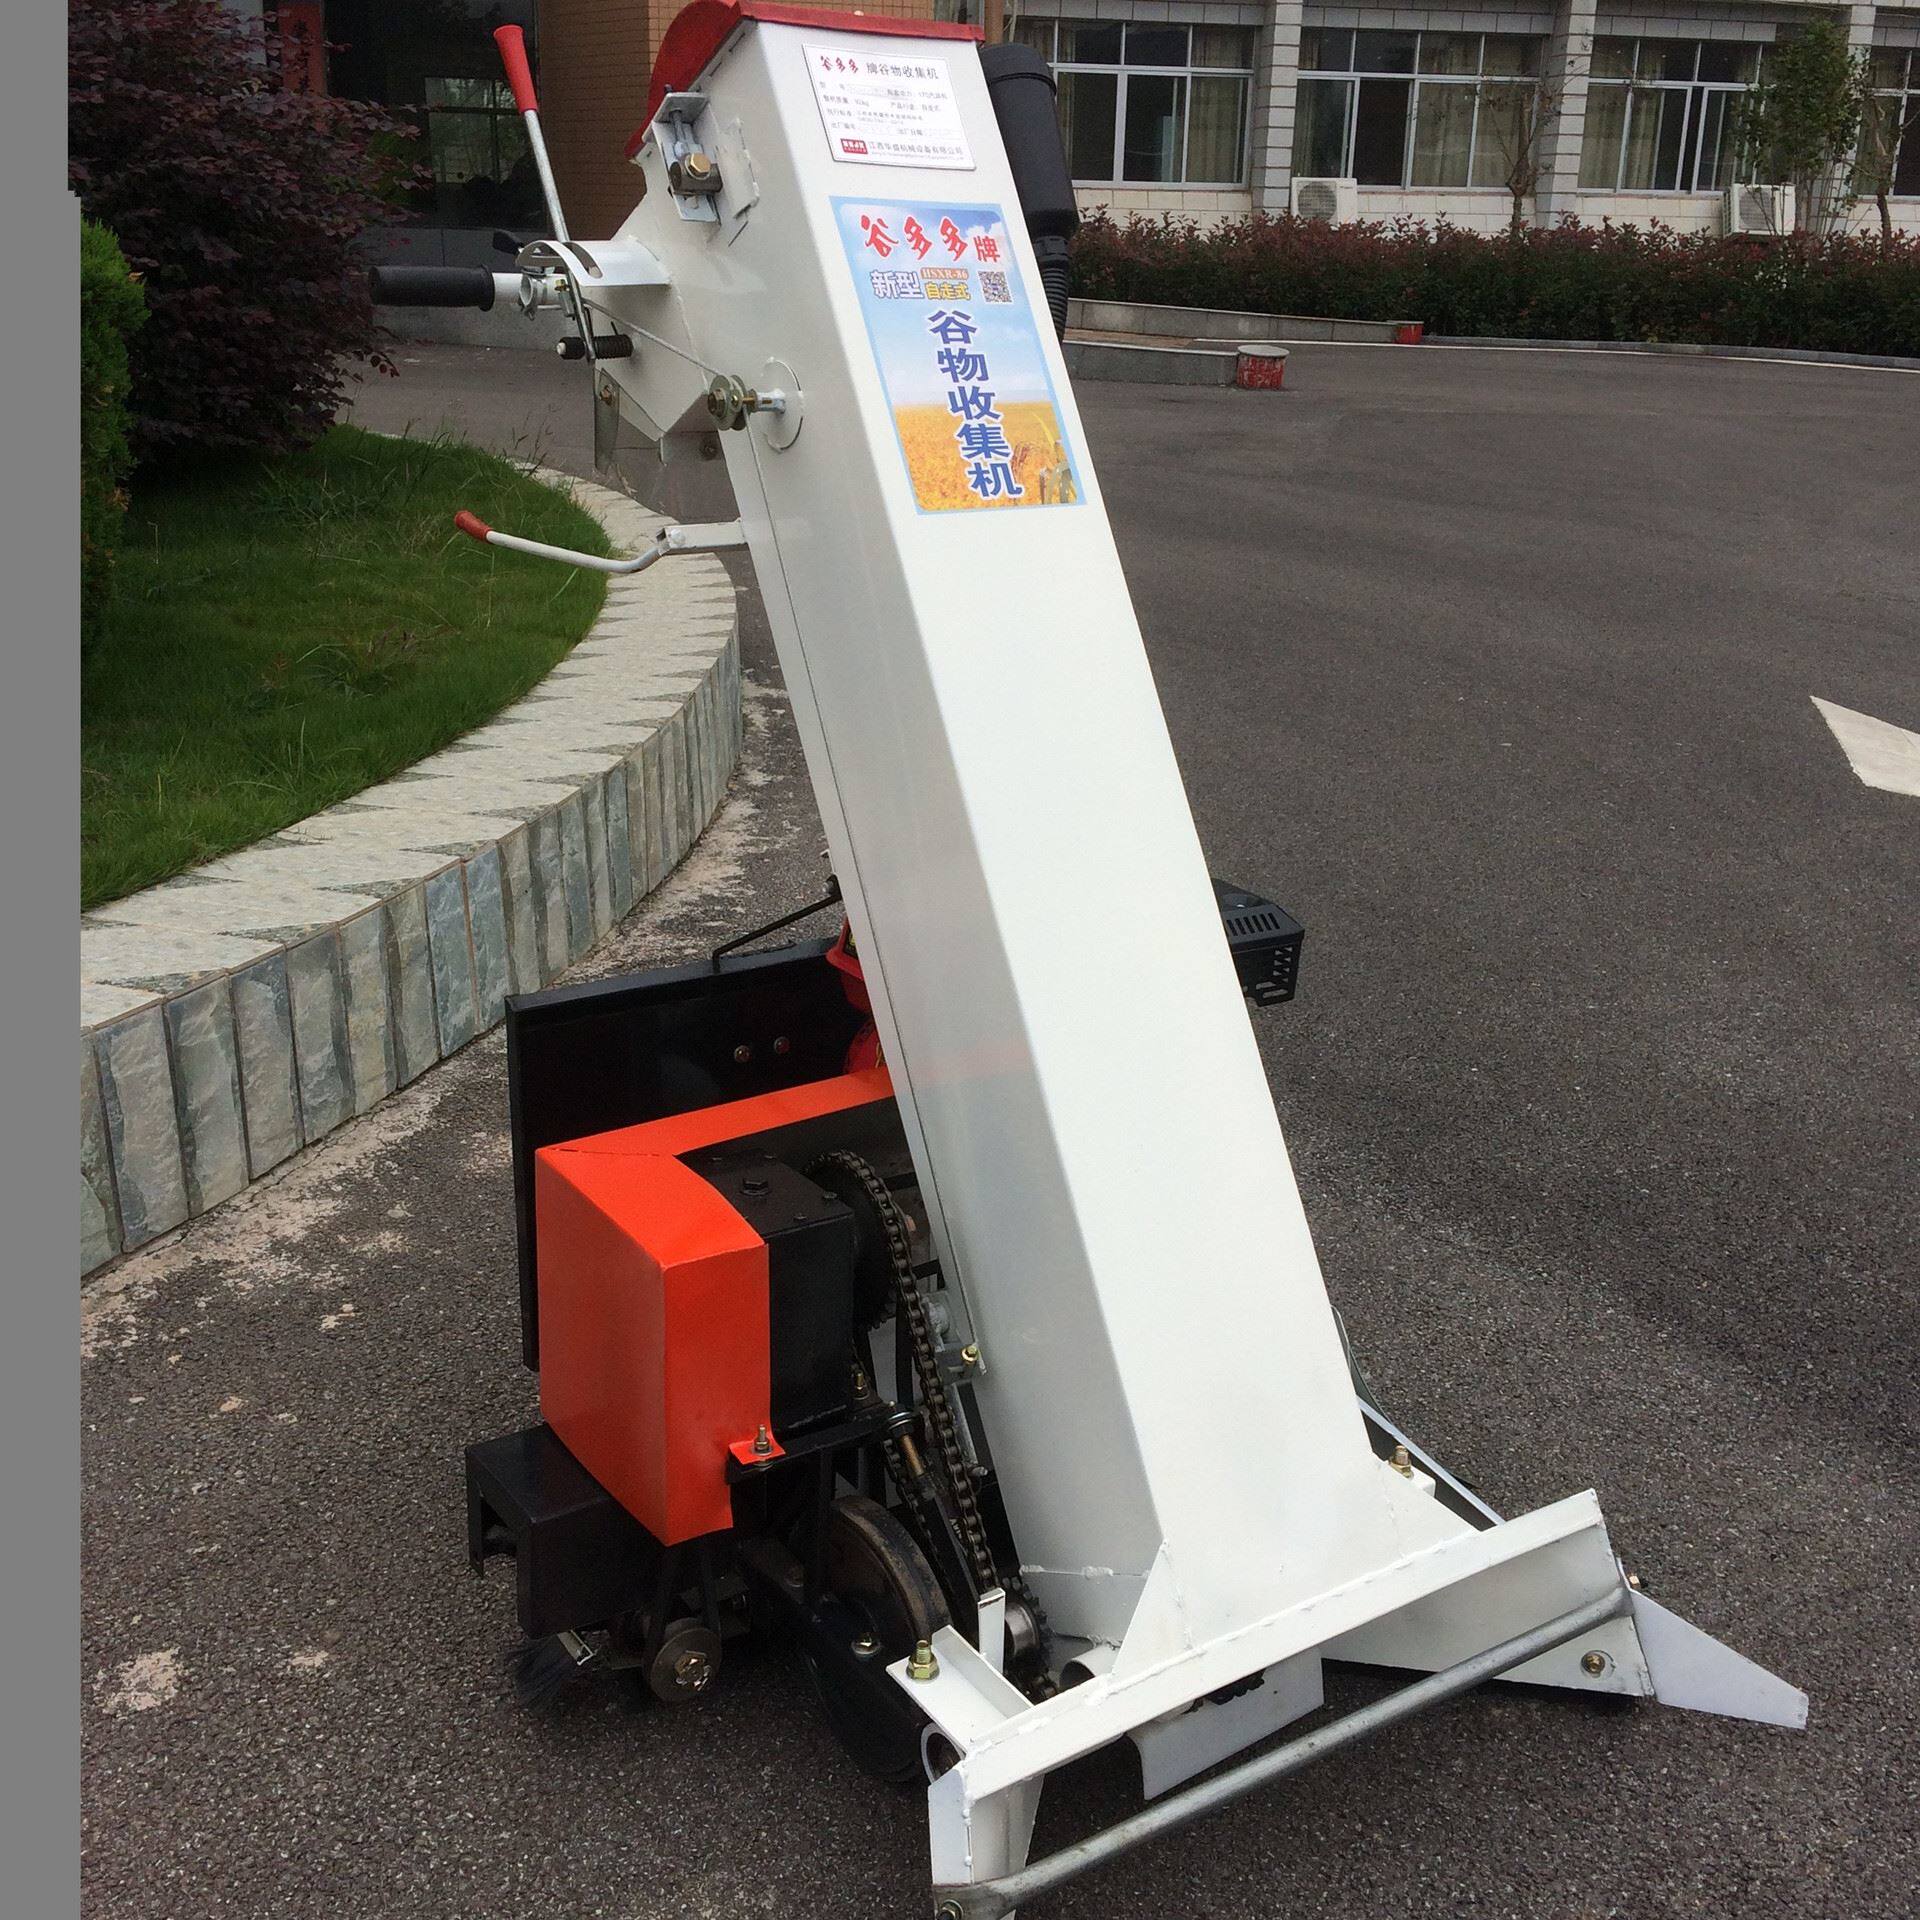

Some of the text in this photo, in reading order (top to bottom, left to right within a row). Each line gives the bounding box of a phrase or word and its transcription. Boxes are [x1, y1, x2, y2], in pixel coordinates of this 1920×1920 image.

[866, 62, 940, 80] 牌谷物收集机
[870, 270, 924, 299] 新型
[925, 282, 971, 301] 自走式
[927, 310, 1022, 499] 谷物收集机
